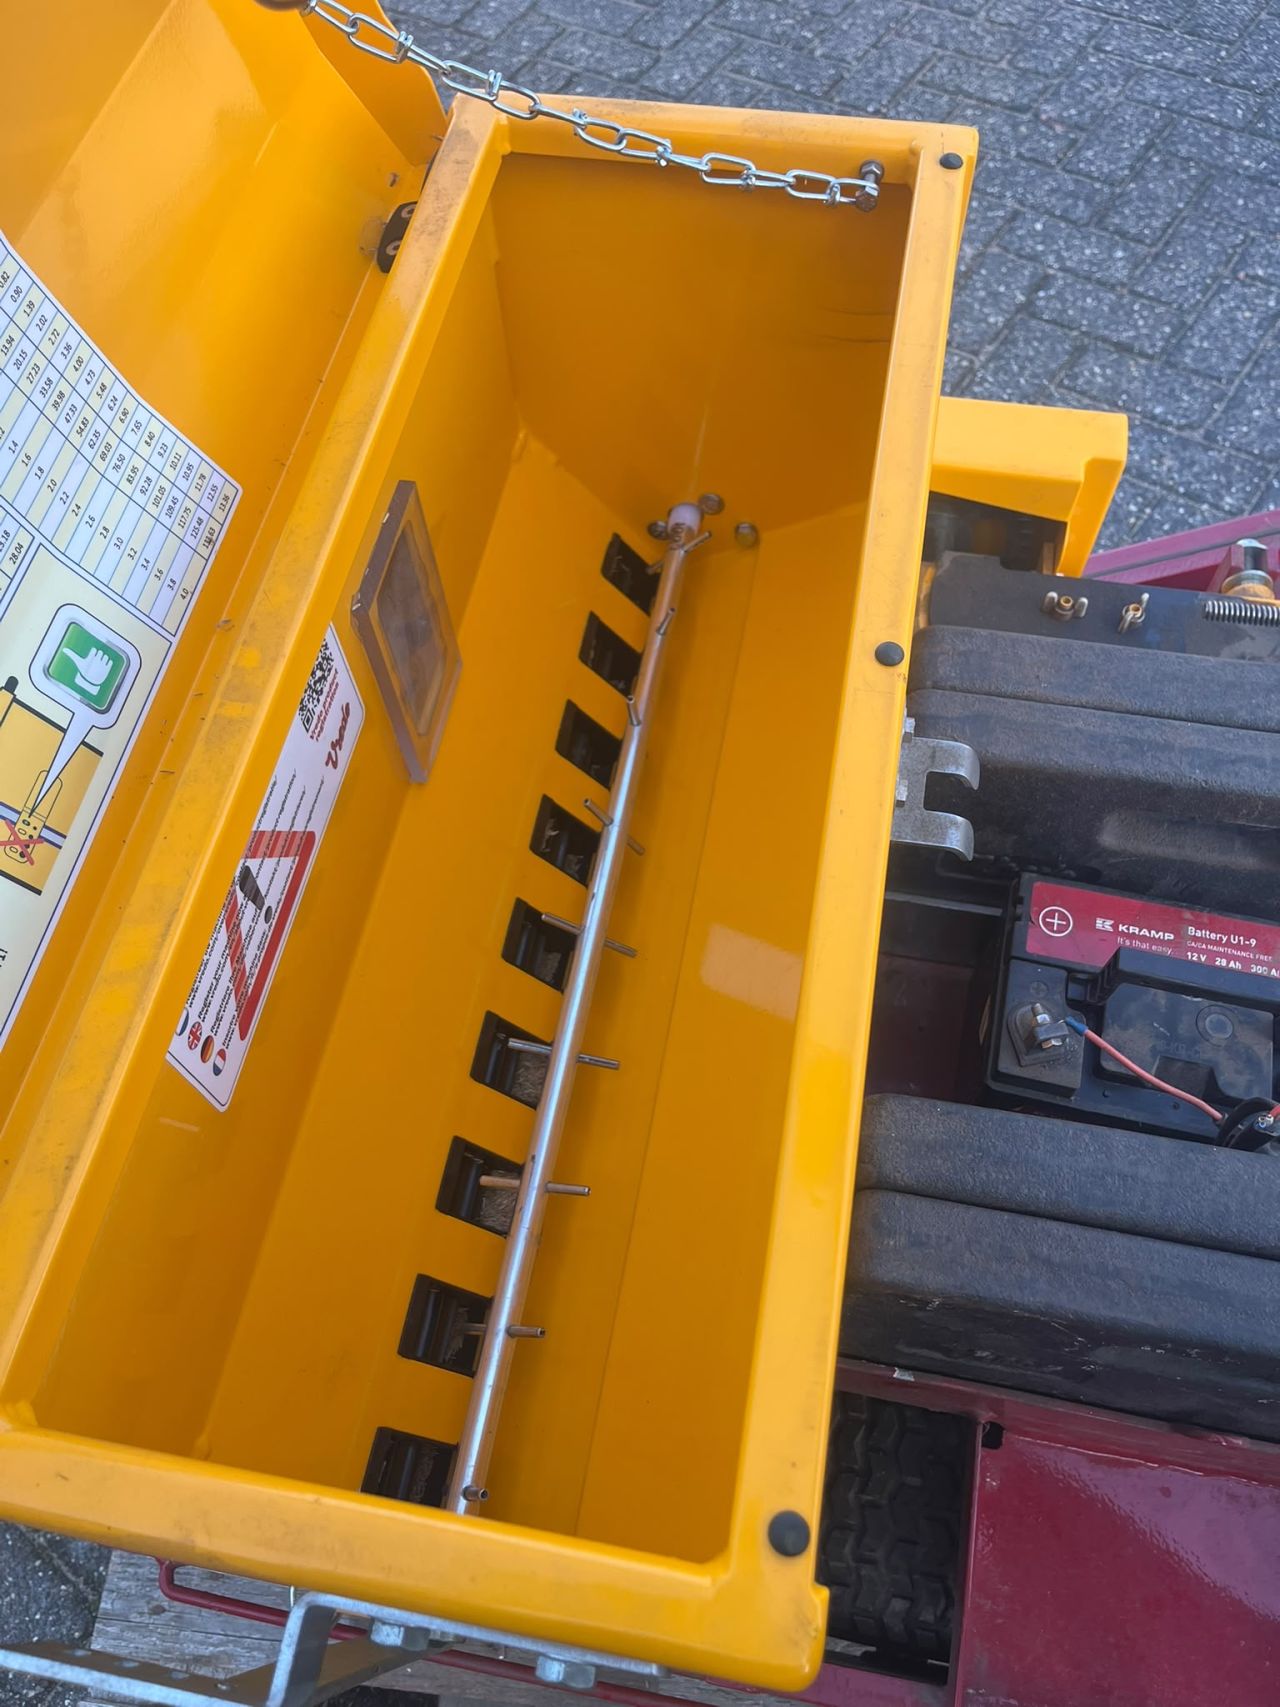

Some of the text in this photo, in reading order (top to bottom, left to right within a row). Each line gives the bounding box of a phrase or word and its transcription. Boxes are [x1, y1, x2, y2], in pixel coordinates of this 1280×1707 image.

[0, 300, 35, 356] 13.94 1.39
[10, 286, 23, 302] 0.90
[13, 314, 48, 371] 20.15 2.02
[9, 343, 72, 454] 1.4 33.58 3.36
[26, 363, 41, 384] 27.23
[48, 329, 60, 346] 2.72
[22, 356, 84, 467] 1.6 39.98 4.00
[35, 370, 96, 480] 1.8 47.33 4.73
[47, 382, 107, 493] 2.0 54.83 5.48
[60, 396, 118, 505] 2.2 62.35 6.24
[72, 408, 129, 517] 2.4 69.03 6.90
[86, 421, 142, 529] 2.6 76.50 7.65
[100, 432, 155, 540] 2.8 83.95 8.40
[114, 443, 168, 550] 3.0 92.28 9.23
[128, 453, 182, 561] 3.2 101.05 10.11
[141, 463, 194, 571] 3.4 109.45 10.95
[154, 474, 206, 582] 3.6 117.75 11.78
[10, 543, 23, 565] 28.04
[167, 484, 218, 591] 3.8 125.48 12.55
[180, 588, 189, 600] 4.0
[219, 494, 230, 512] 13.36
[325, 702, 350, 770] Vredo
[1118, 924, 1257, 948] KRAMP Battery U1-9
[1118, 936, 1130, 946] It's
[1131, 940, 1150, 950] that
[1186, 952, 1198, 961] 12
[1199, 954, 1207, 962] V
[1215, 957, 1227, 966] 28
[1229, 959, 1242, 970] Ah
[1250, 964, 1268, 975] 300
[1208, 944, 1254, 959] MAINTENANCE
